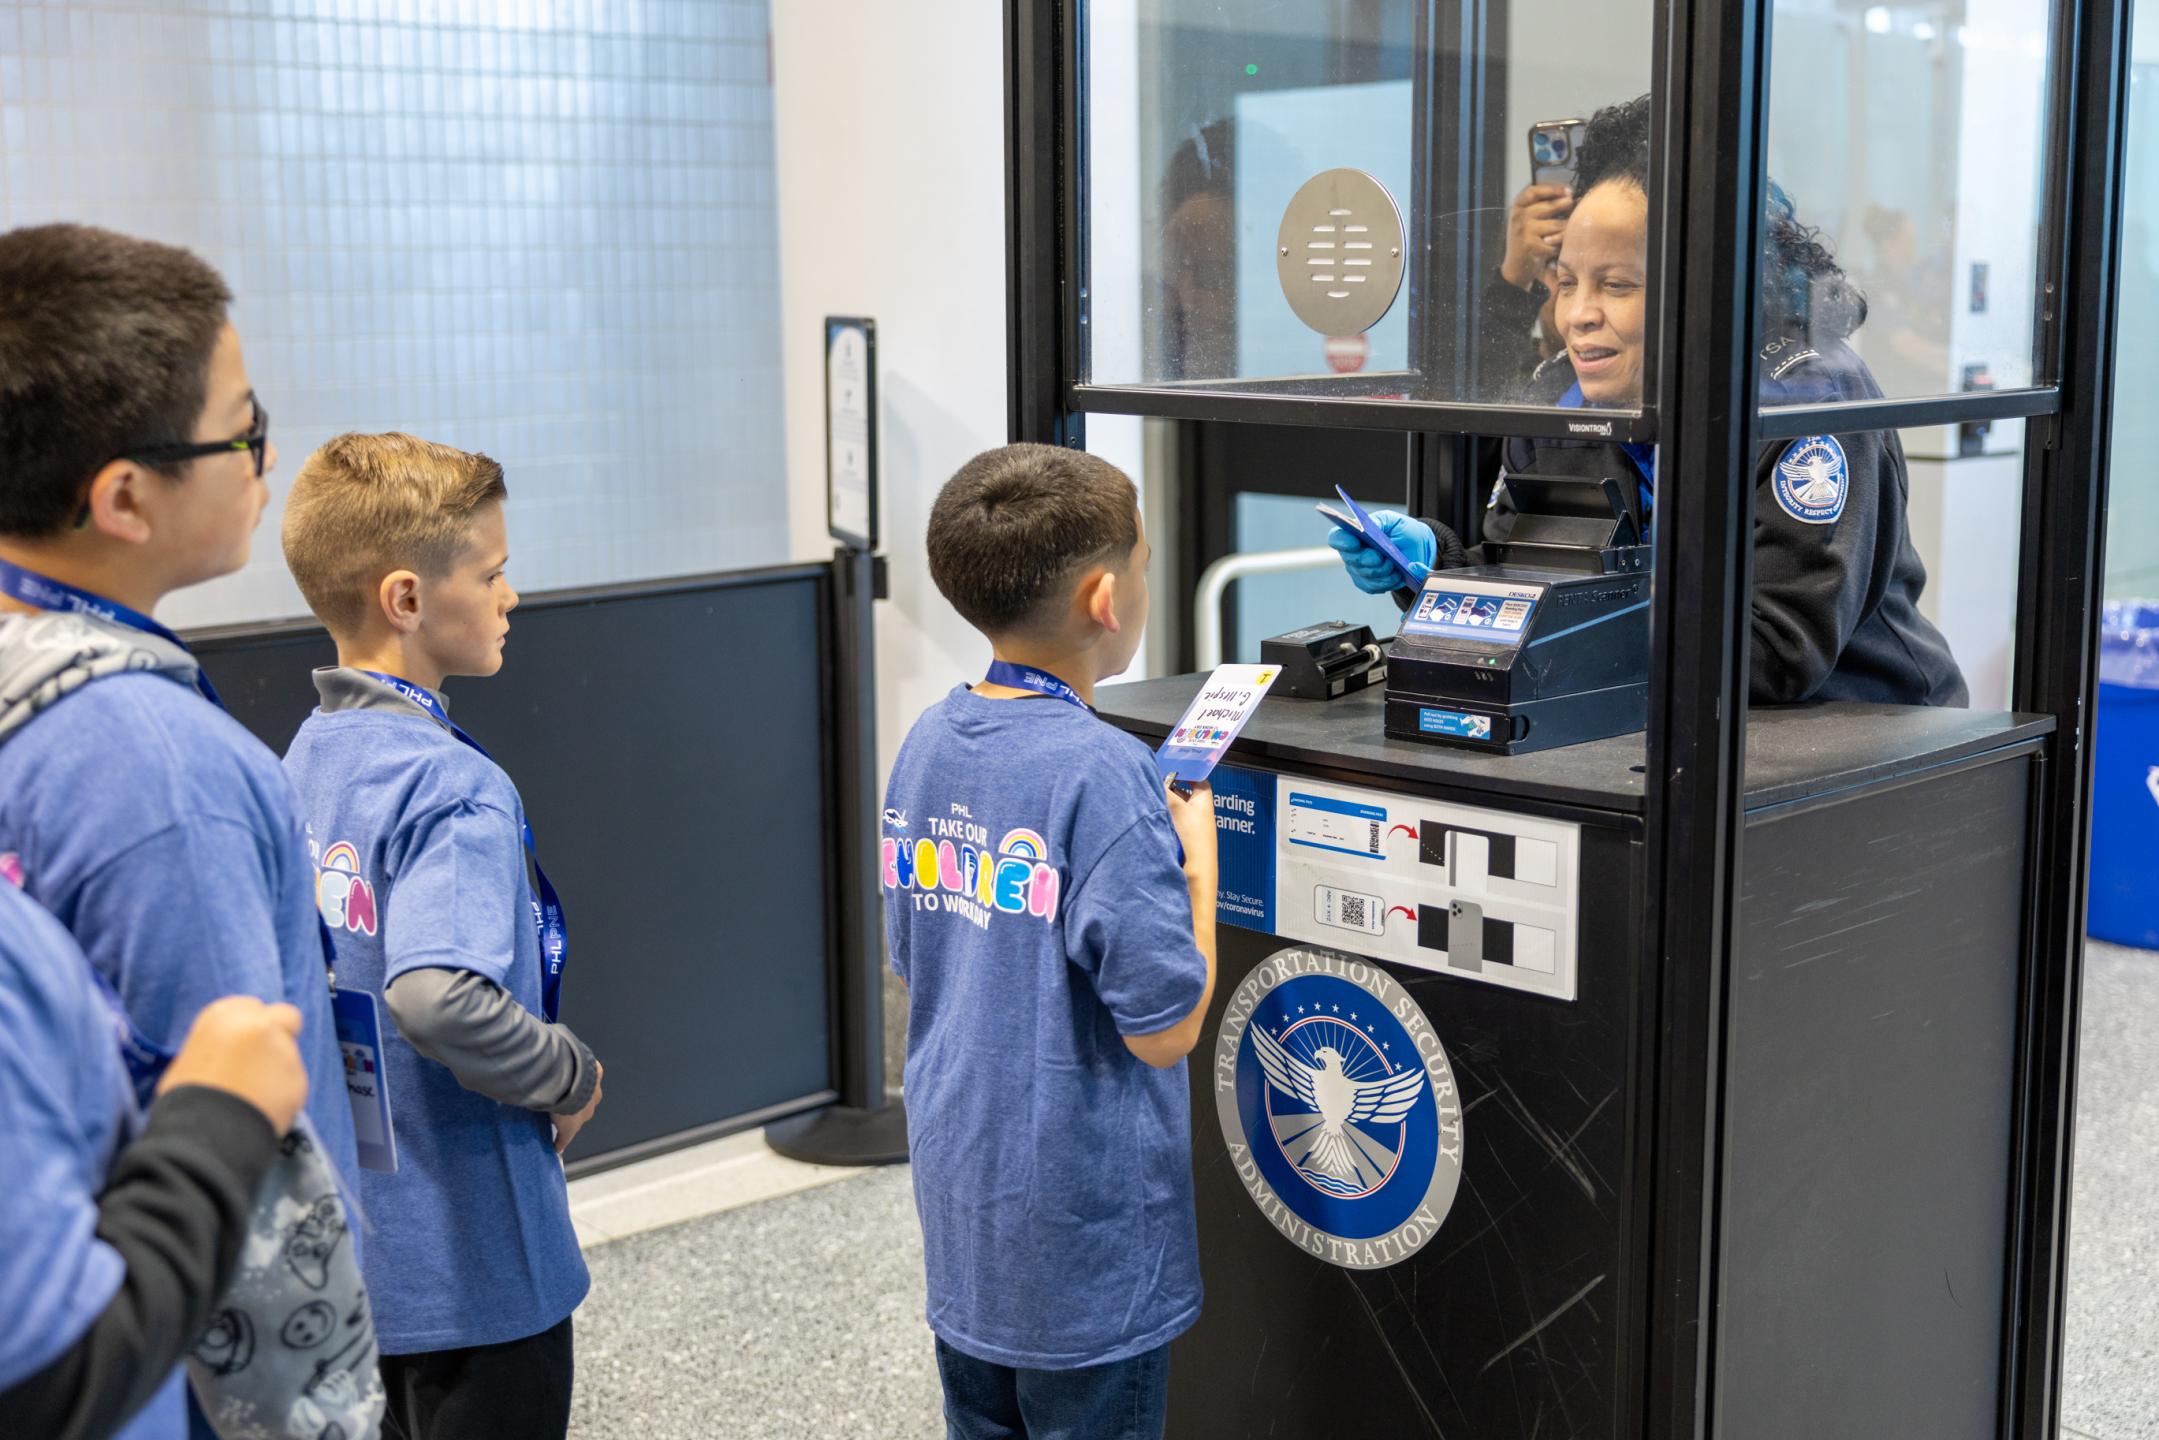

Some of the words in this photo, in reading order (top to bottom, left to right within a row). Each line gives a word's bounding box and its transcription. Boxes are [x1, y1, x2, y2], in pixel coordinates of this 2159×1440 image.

[1568, 423, 1606, 433] VISIONTRON
[400, 684, 432, 707] PHL
[1197, 709, 1244, 722] Michael
[951, 803, 973, 818] PHL
[1213, 794, 1255, 816] arding
[928, 817, 964, 839] TAKE
[965, 823, 988, 847] OUR
[1215, 815, 1255, 835] anner.
[912, 893, 939, 911] TO
[1226, 890, 1240, 902] Stay
[1216, 901, 1264, 918] ov/coronavirus
[1217, 949, 1392, 1093] TRANSPORTATION
[1393, 997, 1460, 1166] SECURITY
[1229, 1141, 1440, 1266] ADMINISTRATION
